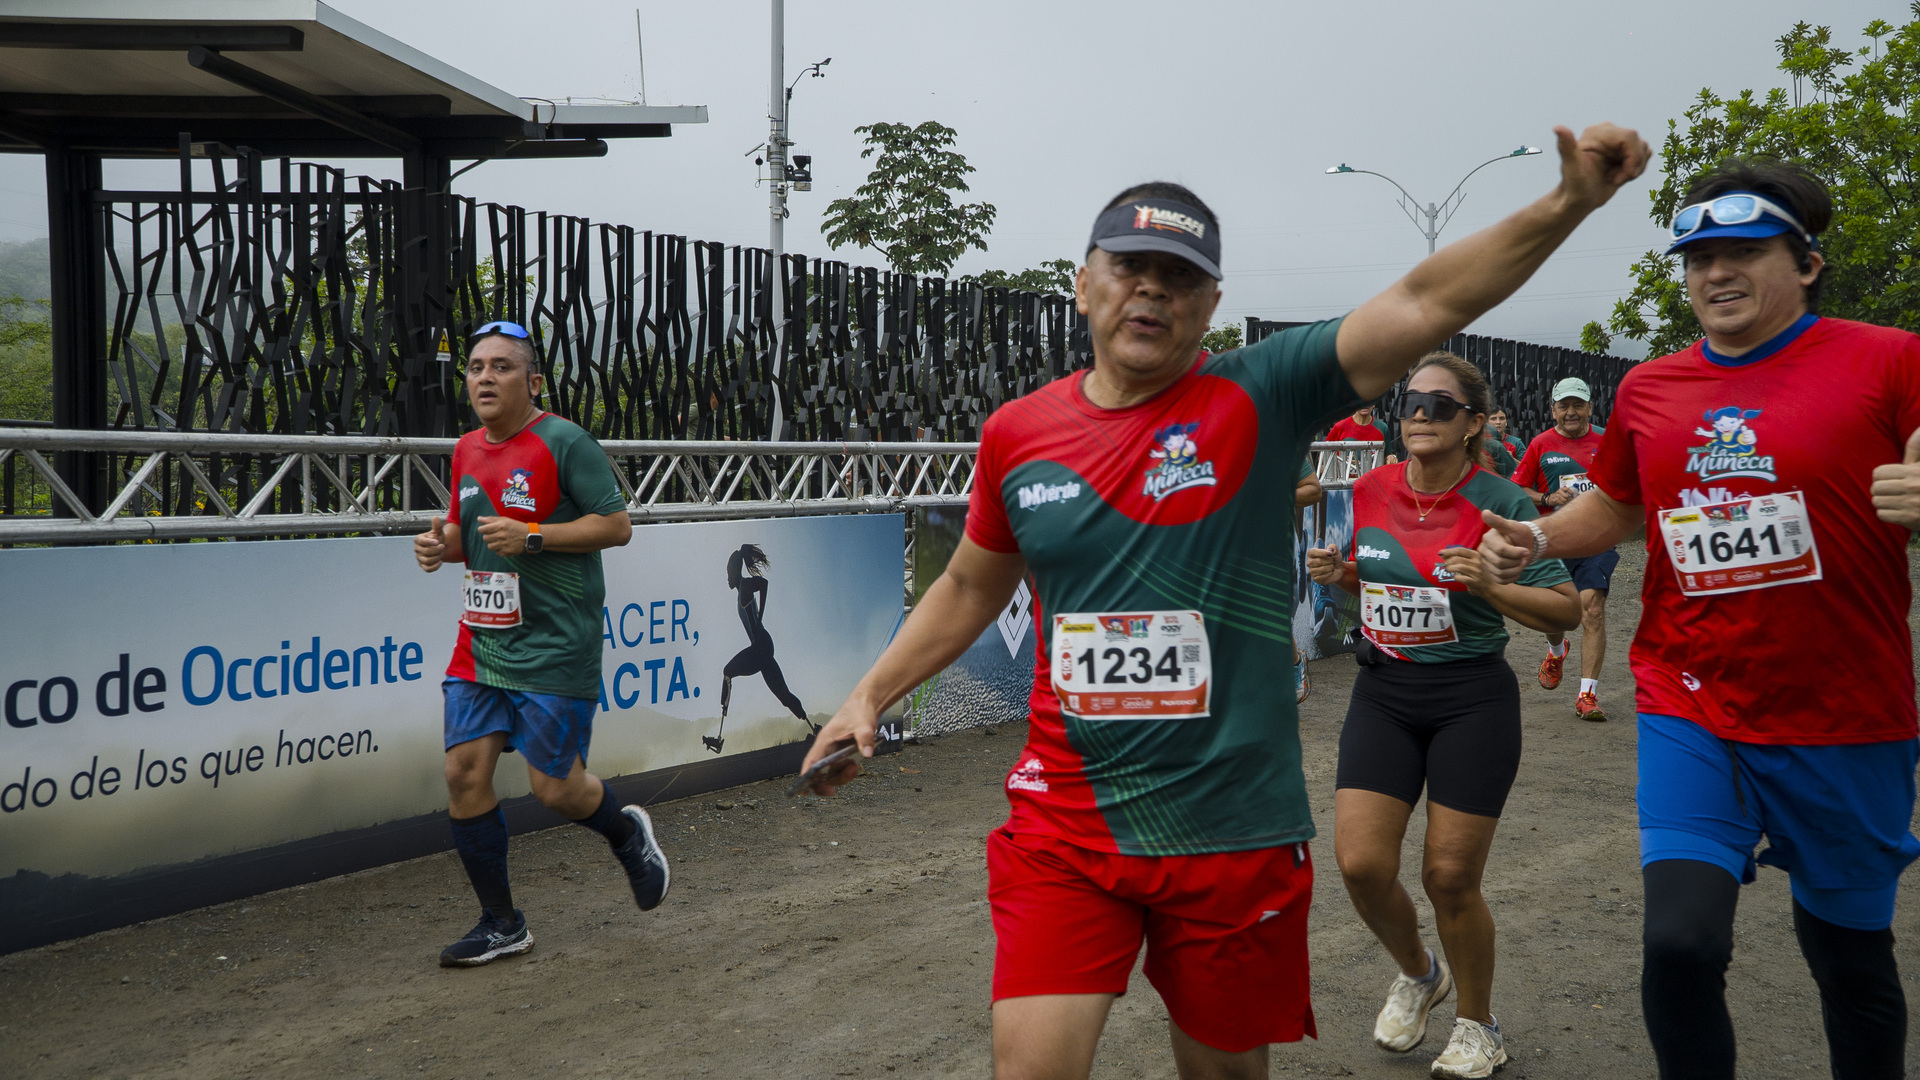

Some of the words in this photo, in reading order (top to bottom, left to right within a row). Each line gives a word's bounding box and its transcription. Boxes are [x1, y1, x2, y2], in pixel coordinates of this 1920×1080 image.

[1686, 453, 1775, 477] Muñeca
[501, 493, 535, 507] Muñeca
[1689, 524, 1782, 565] 1641
[466, 587, 505, 609] 1670
[1375, 604, 1433, 628] 1077
[1078, 646, 1182, 684] 1234
[5, 675, 79, 728] co
[96, 653, 167, 717] de
[182, 636, 423, 706] Occidente
[1, 767, 57, 813] do
[70, 756, 121, 799] de
[134, 749, 188, 790] los
[200, 745, 265, 788] que
[276, 729, 380, 767] hacen.
